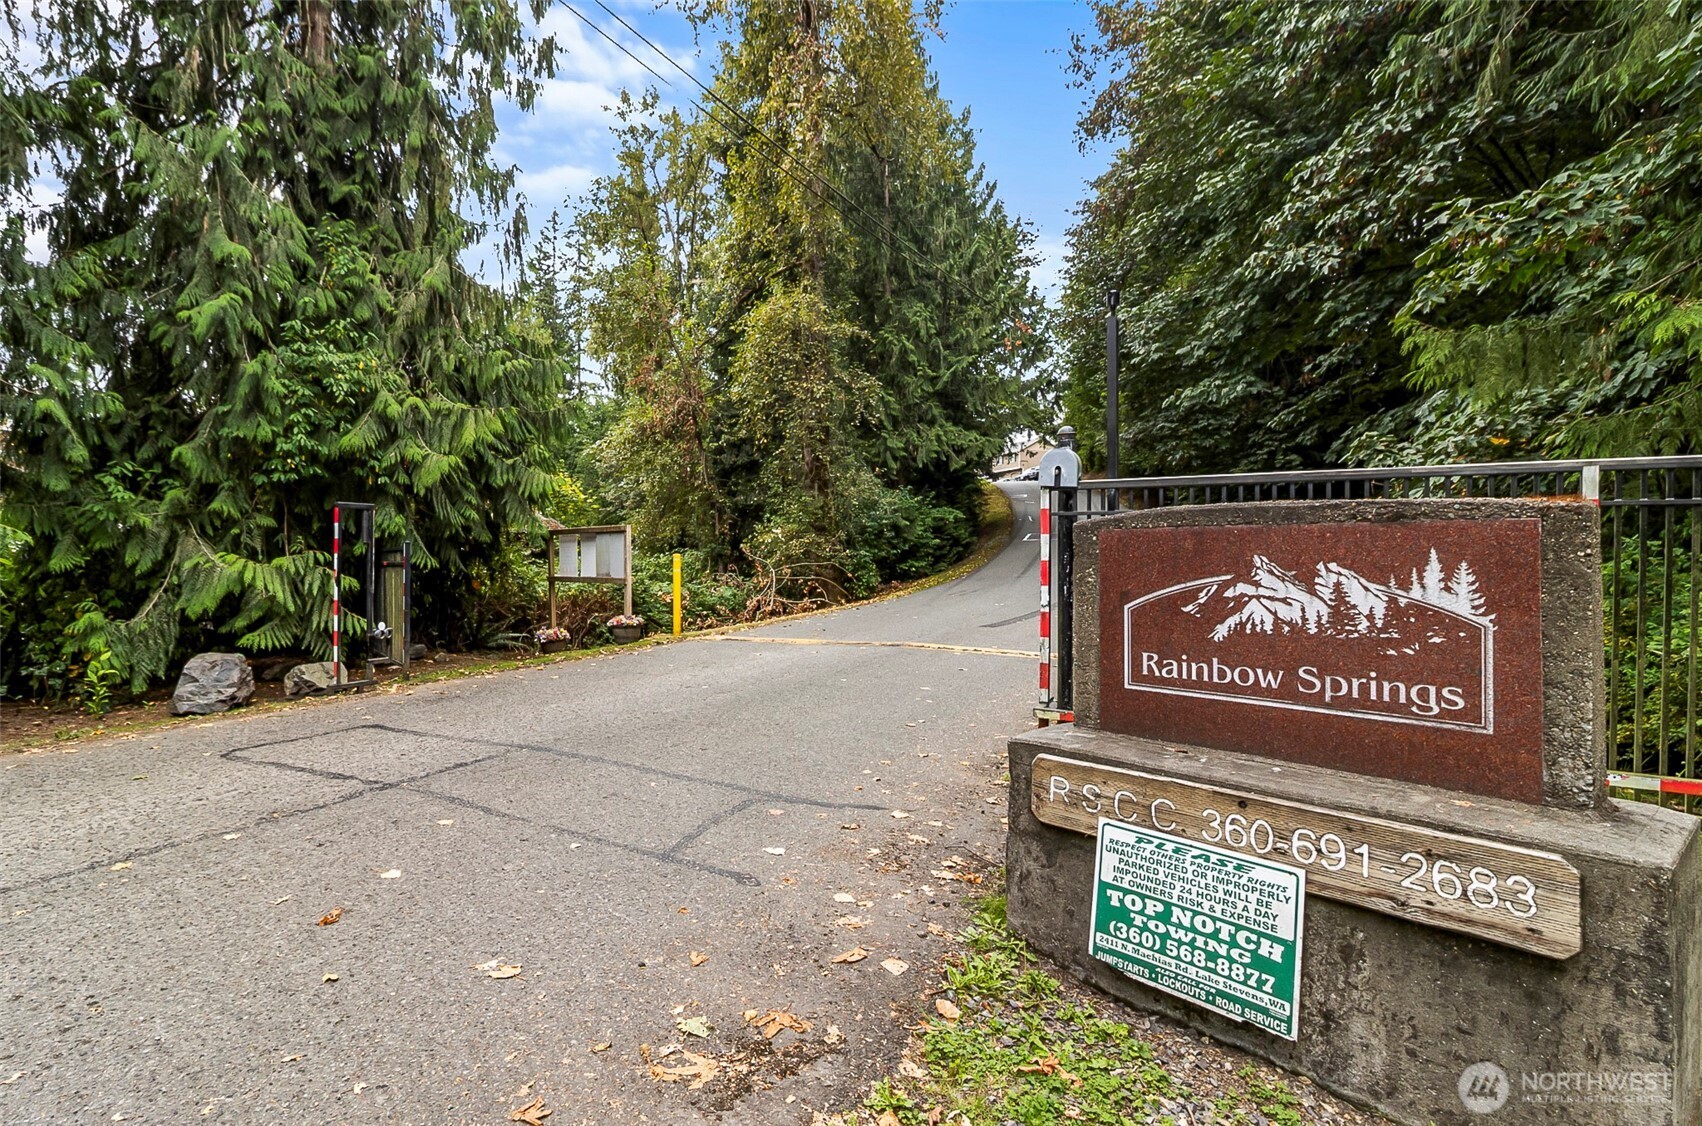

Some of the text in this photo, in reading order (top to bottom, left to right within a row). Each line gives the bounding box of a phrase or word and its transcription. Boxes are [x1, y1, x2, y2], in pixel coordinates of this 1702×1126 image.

[1141, 651, 1465, 716] Rainbow Springs
[1105, 844, 1291, 905] UNAUTHORIZED OR IMPROPERLY
[1108, 838, 1288, 893] RESPECT OTHERS PROPERTY RIGHTS
[1118, 857, 1273, 910] PARKED VEHICLES WILL BE
[1134, 835, 1256, 874] PLEASE
[1201, 807, 1538, 919] 360-691-2683
[1111, 874, 1279, 934] AT OWNERS RISK & EXPENSE
[1112, 865, 1279, 922] IMPOUNDED 24 HOURS A DAY
[1106, 888, 1285, 964] TOP NOTCH
[1129, 912, 1252, 964] TOWING
[1099, 935, 1119, 948] 2411
[1131, 946, 1173, 969] Machias
[1174, 962, 1192, 975] Rd.
[1195, 970, 1220, 986] Lake
[1109, 920, 1276, 994] (360) 568-8877
[1155, 967, 1176, 978] ALSO
[1198, 983, 1217, 994] FOR
[1095, 950, 1150, 978] JUMPSTARTS
[1157, 973, 1206, 1001] LOCKOUTS
[1215, 996, 1242, 1015] ROAD
[1244, 1007, 1288, 1034] SERVICE
